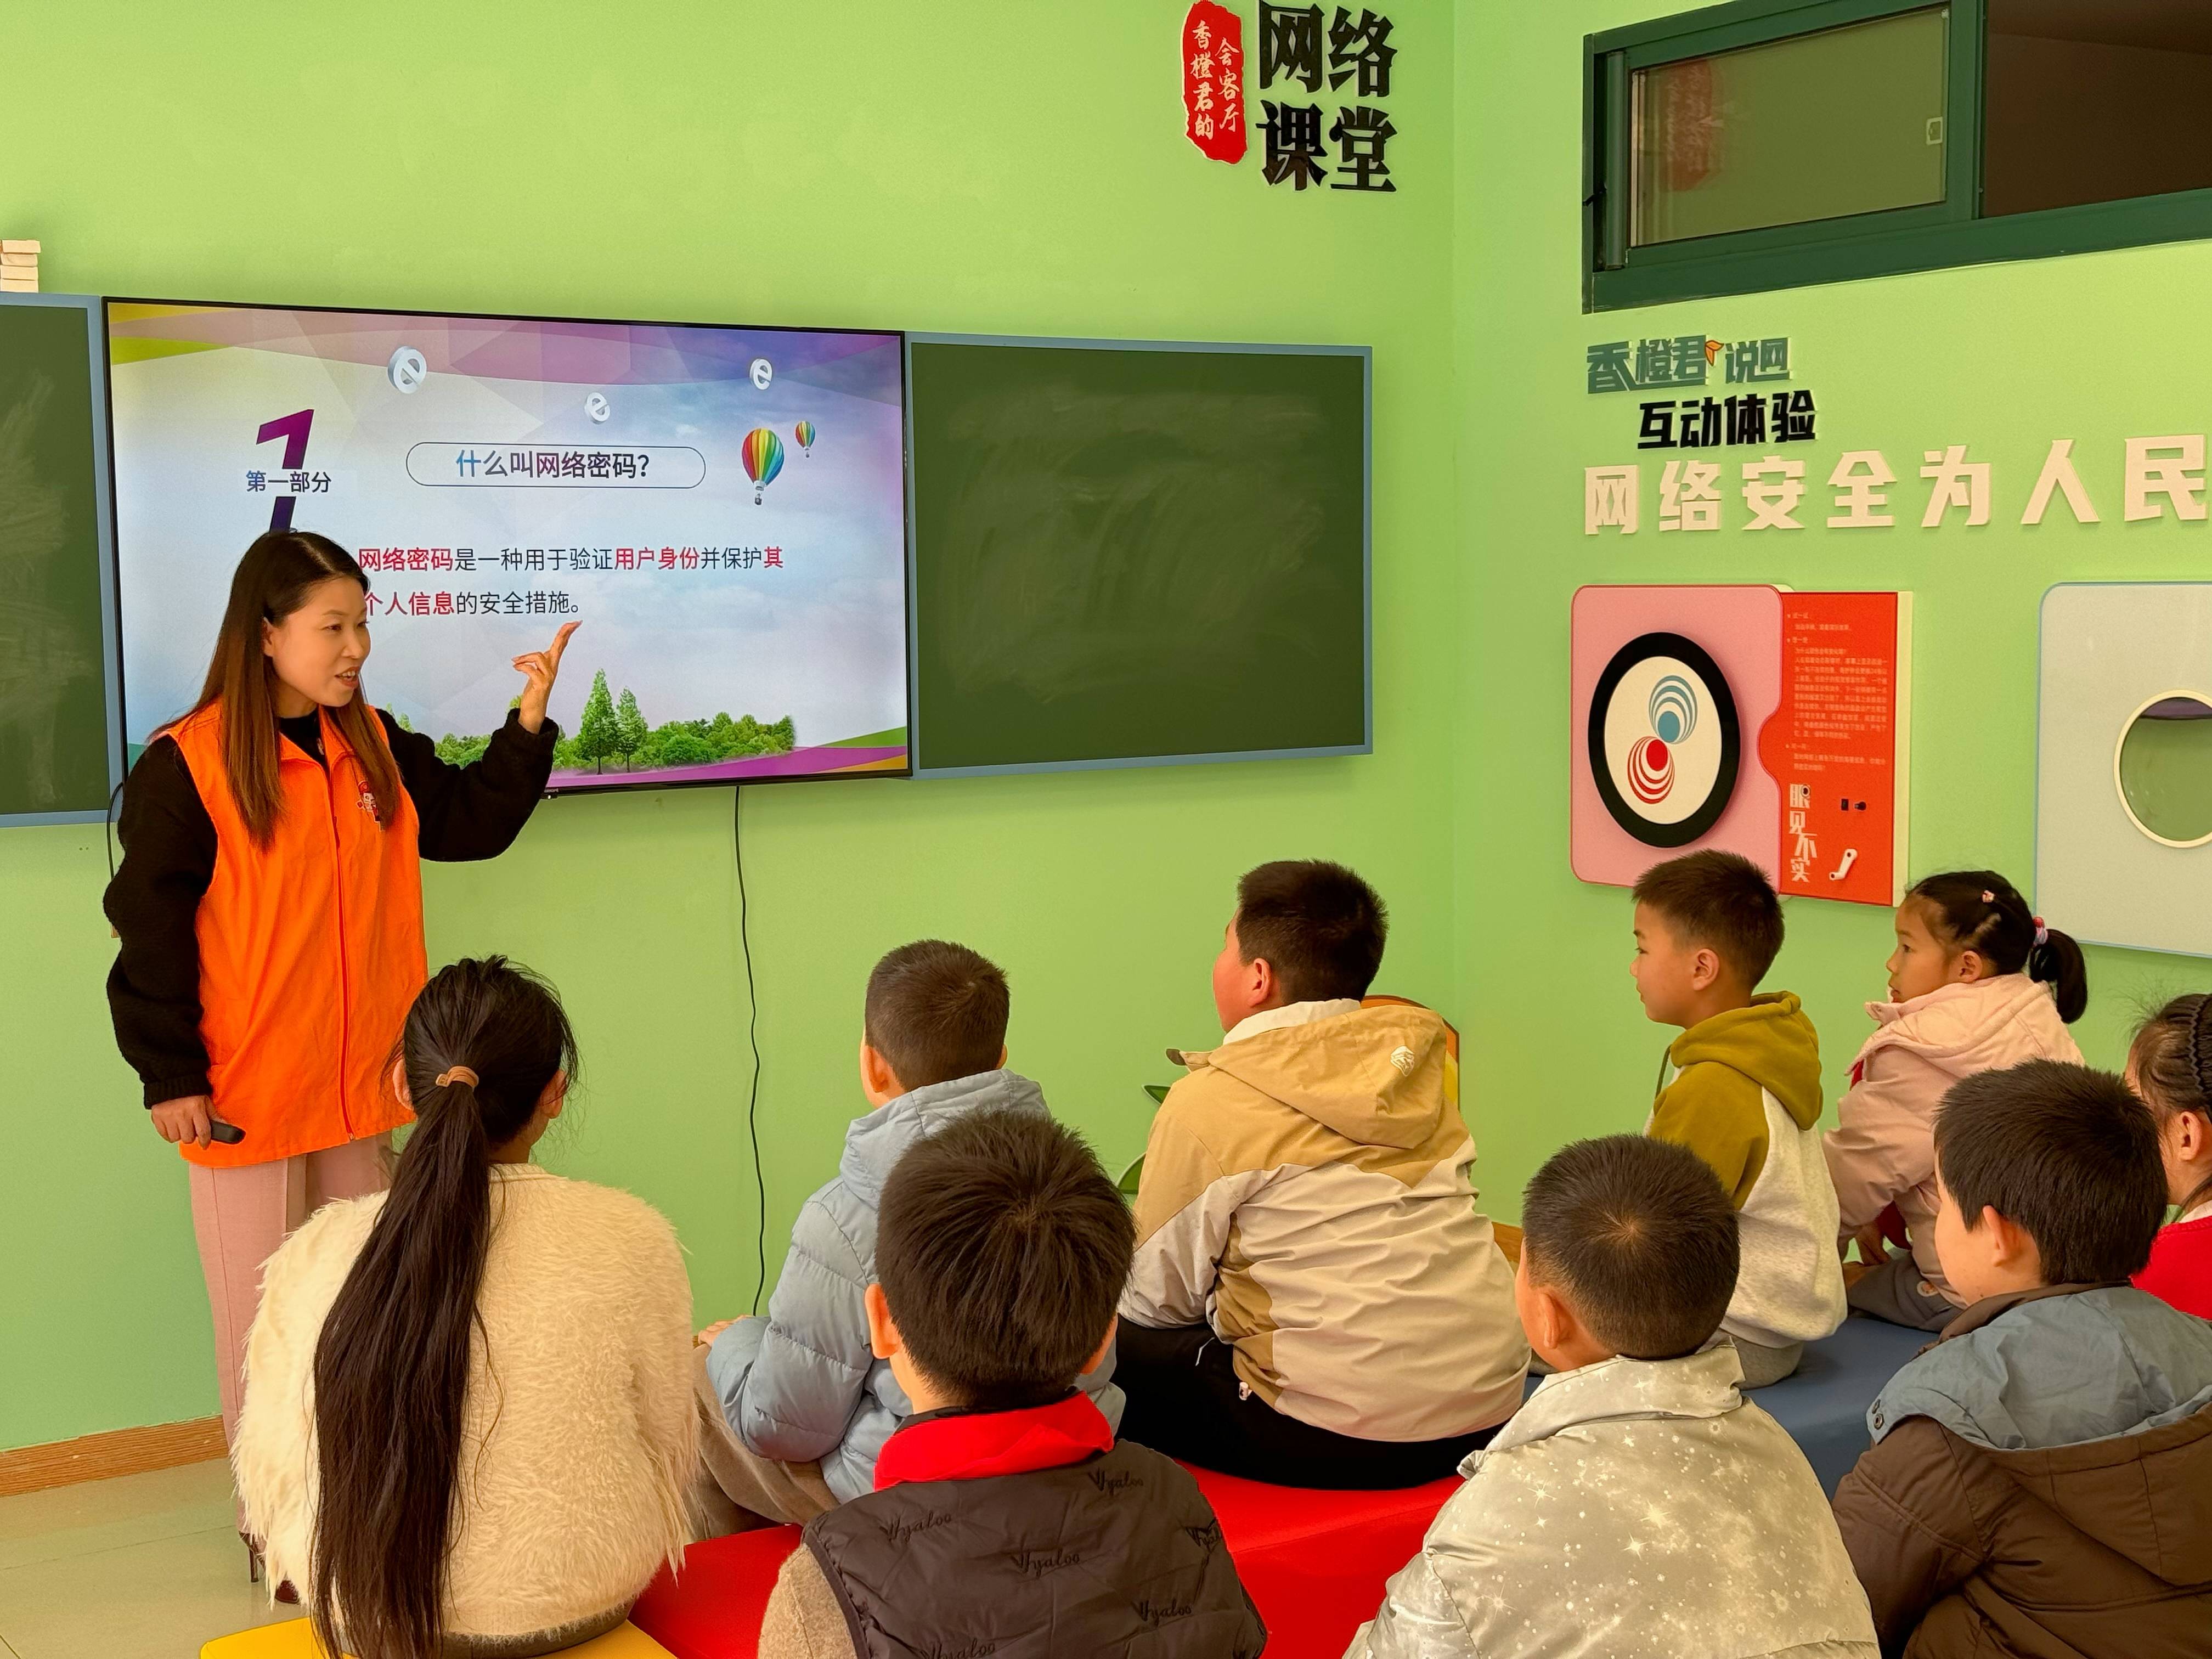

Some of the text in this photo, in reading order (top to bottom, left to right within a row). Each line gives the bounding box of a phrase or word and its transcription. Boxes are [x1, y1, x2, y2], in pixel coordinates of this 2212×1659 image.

[1190, 20, 1215, 140] 香橙君的
[1215, 37, 1240, 132] 会客厅
[1259, 0, 1398, 97] 网络
[1255, 100, 1397, 191] 课堂
[1638, 390, 1816, 449] 互动体验
[246, 470, 331, 493] 第一部分
[456, 450, 650, 478] 什么叫网络密码?
[1584, 435, 2208, 535] 网络安全为人民
[359, 546, 783, 572] 网络密码是一种用于验证用户身份并保护其
[364, 591, 578, 616] 个人信息的安全措施。
